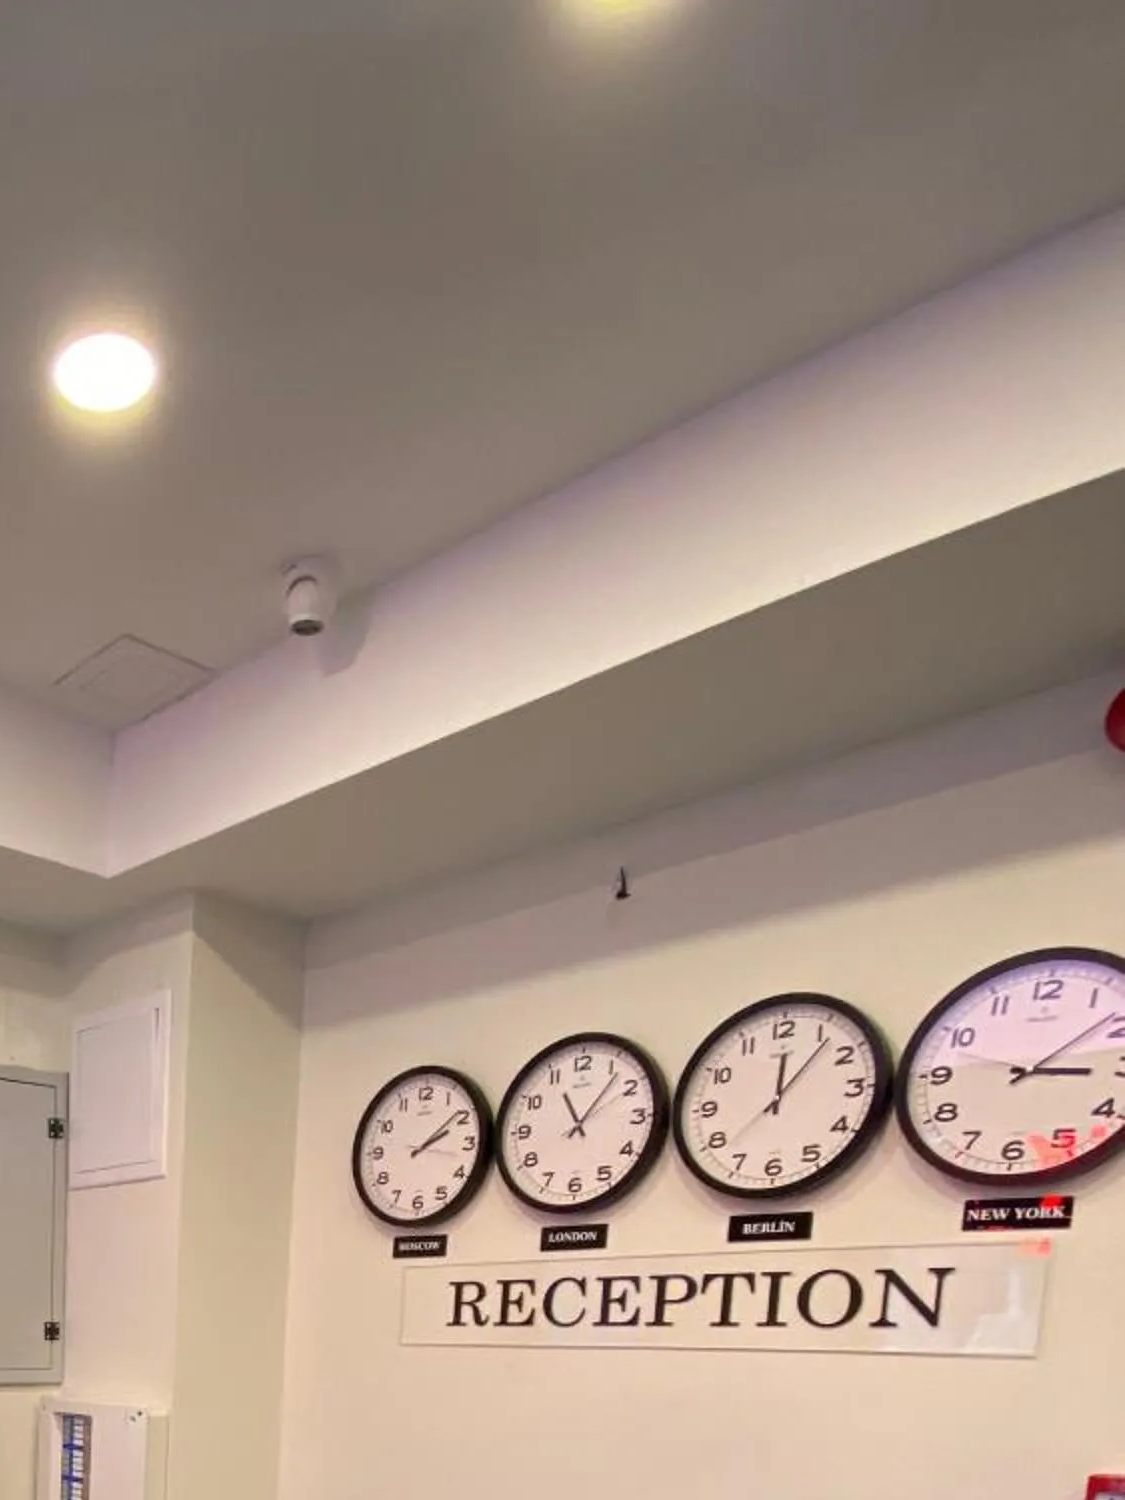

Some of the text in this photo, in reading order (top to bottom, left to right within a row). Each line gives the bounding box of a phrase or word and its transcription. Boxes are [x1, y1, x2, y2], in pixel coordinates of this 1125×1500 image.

[1033, 980, 1064, 1000] 12
[1089, 988, 1097, 1008] 1
[991, 996, 1009, 1016] 11
[773, 1021, 795, 1040] 12
[818, 1024, 823, 1042] 1
[1107, 1017, 1125, 1038] 2
[742, 1037, 755, 1055] 11
[951, 1028, 975, 1048] 10
[834, 1046, 854, 1065] 2
[574, 1056, 592, 1072] 12
[609, 1060, 613, 1075] 1
[550, 1069, 560, 1085] 11
[714, 1067, 732, 1084] 10
[930, 1066, 953, 1085] 9
[419, 1087, 434, 1101] 12
[623, 1080, 638, 1096] 2
[844, 1078, 864, 1097] 3
[399, 1098, 407, 1112] 11
[447, 1092, 450, 1106] 1
[528, 1095, 542, 1110] 10
[630, 1108, 645, 1124] 3
[701, 1101, 718, 1117] 9
[935, 1103, 958, 1122] 8
[1091, 1098, 1115, 1118] 4
[457, 1110, 470, 1125] 2
[830, 1116, 848, 1133] 4
[380, 1120, 393, 1133] 10
[518, 1125, 531, 1140] 9
[462, 1136, 475, 1151] 3
[708, 1131, 727, 1148] 8
[962, 1131, 981, 1150] 7
[1051, 1128, 1075, 1147] 5
[372, 1147, 383, 1160] 9
[619, 1141, 633, 1156] 4
[801, 1144, 821, 1161] 5
[1001, 1140, 1025, 1160] 6
[523, 1152, 538, 1167] 8
[732, 1154, 747, 1170] 7
[764, 1159, 782, 1176] 6
[377, 1172, 389, 1185] 8
[453, 1165, 465, 1179] 4
[543, 1172, 555, 1187] 7
[596, 1165, 612, 1181] 5
[435, 1186, 448, 1200] 5
[568, 1178, 581, 1193] 6
[392, 1190, 402, 1203] 7
[412, 1196, 423, 1209] 6
[967, 1206, 1064, 1221] NEW YORK
[548, 1231, 597, 1242] LONDON
[446, 1267, 956, 1329] RECEPTION
